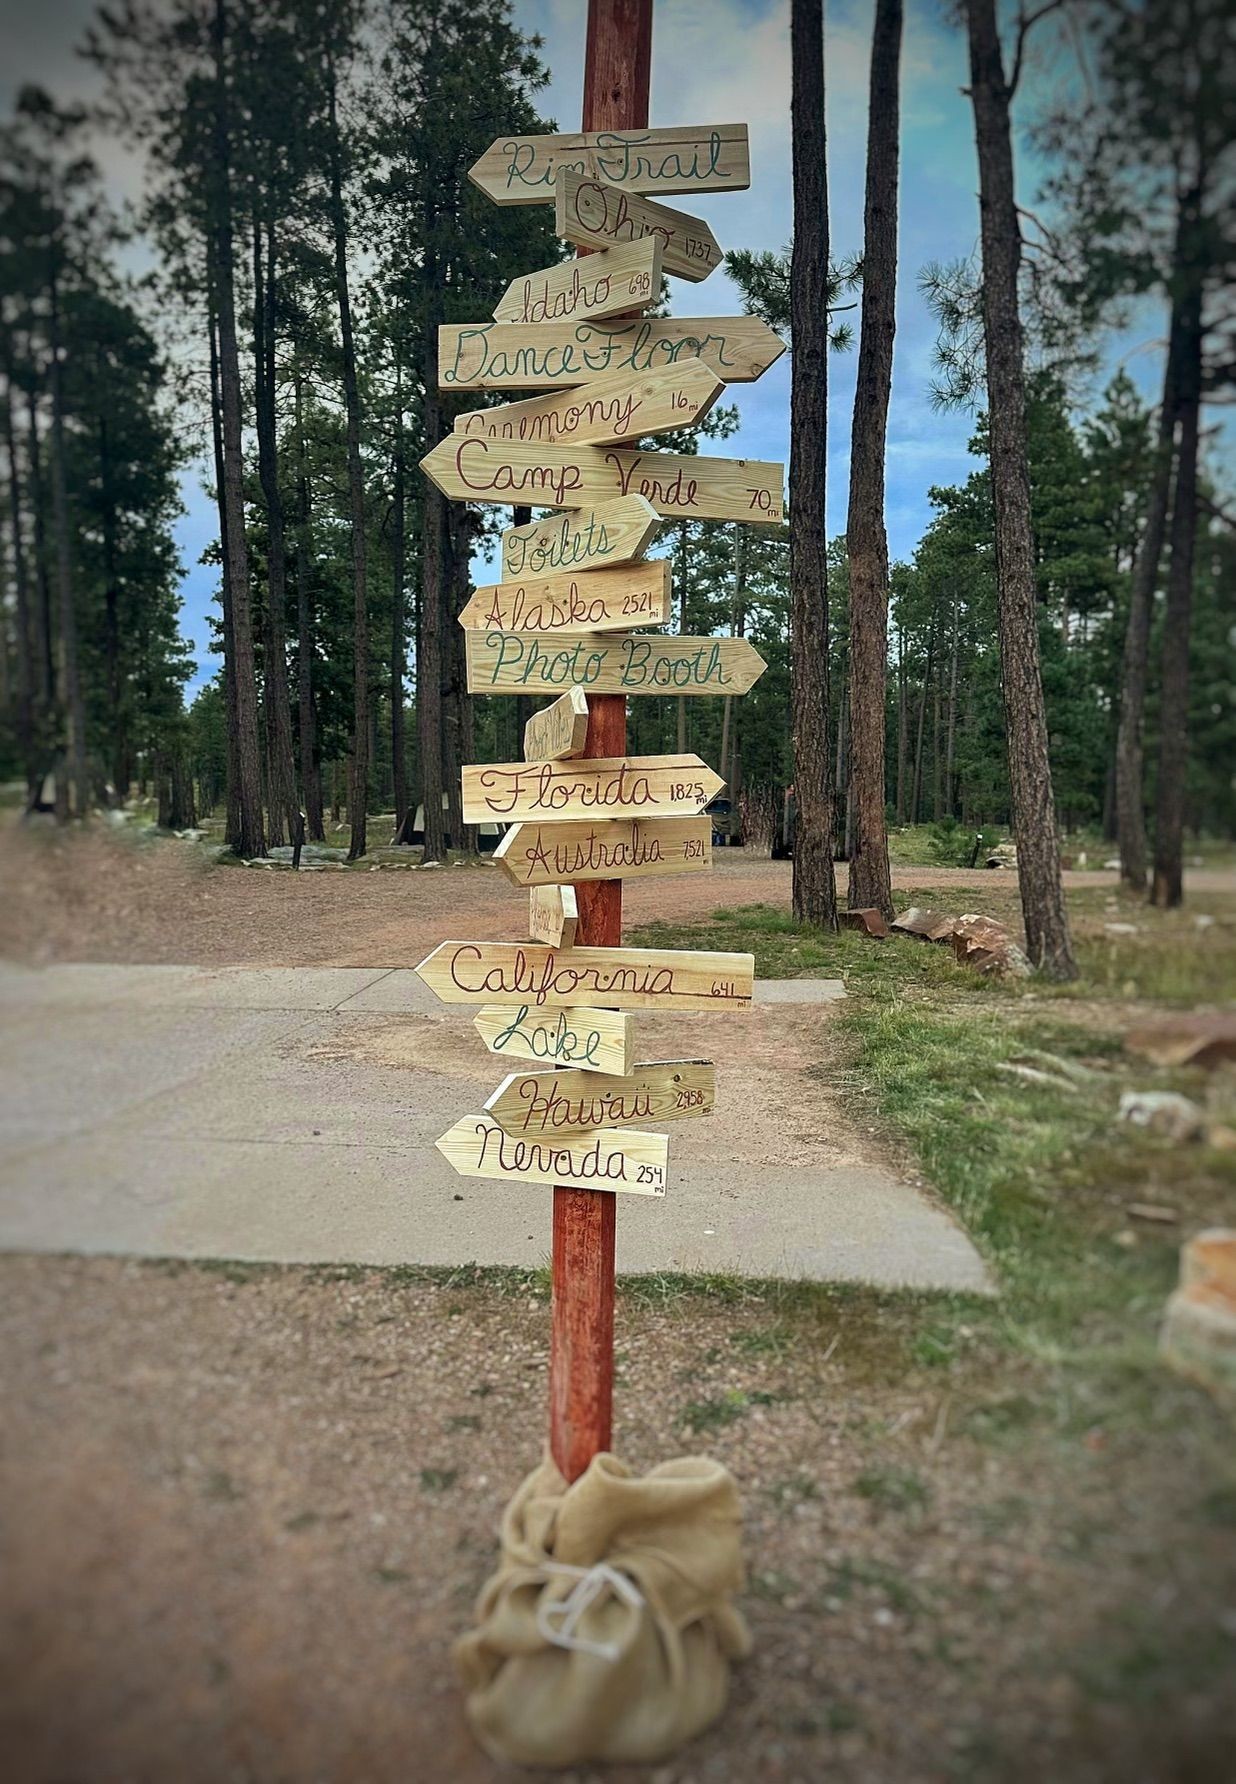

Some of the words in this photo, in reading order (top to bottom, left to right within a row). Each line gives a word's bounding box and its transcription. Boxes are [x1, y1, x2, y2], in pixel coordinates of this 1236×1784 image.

[502, 141, 585, 188] Rim
[597, 131, 731, 182] Trail
[576, 182, 676, 250] Ohio
[510, 268, 613, 323] Idaho
[628, 271, 650, 295] 698
[444, 325, 581, 383] Dance
[575, 322, 735, 371] Floor
[688, 400, 699, 411] mi
[456, 438, 584, 505] Camp
[605, 453, 699, 507] Verde
[746, 489, 772, 510] 70
[767, 509, 779, 517] mi
[507, 512, 617, 576] Toilets
[484, 582, 611, 632] Alaska
[485, 631, 609, 685] Photo
[620, 636, 732, 687] Booth
[480, 763, 660, 813] Florida
[696, 795, 708, 805] mi
[525, 822, 665, 880] Australia
[450, 945, 675, 1006] California
[710, 980, 735, 997] 641
[736, 1000, 747, 1009] mi
[492, 1004, 601, 1067] Lake
[518, 1079, 655, 1131] Hawaii
[475, 1123, 629, 1181] Nevada
[636, 1164, 663, 1184] 254
[654, 1185, 665, 1194] mi
